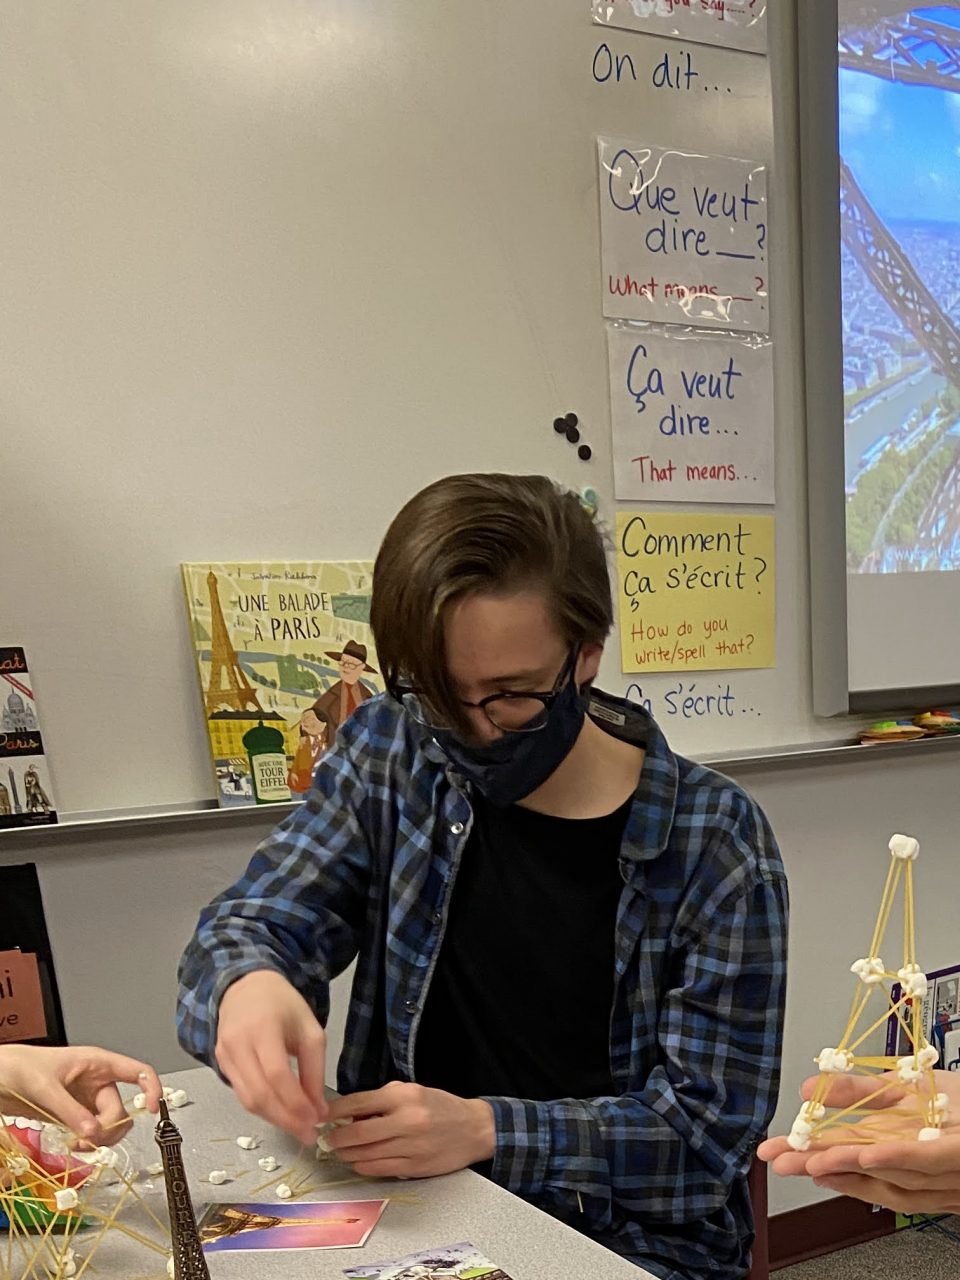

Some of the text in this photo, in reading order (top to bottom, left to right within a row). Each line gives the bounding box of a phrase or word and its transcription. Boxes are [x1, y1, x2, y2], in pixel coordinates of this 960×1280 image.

[592, 44, 636, 82] On
[609, 150, 759, 220] Que veut
[609, 274, 659, 298] What
[627, 344, 742, 413] Ça veut
[632, 456, 677, 483] That
[622, 517, 752, 557] Comment
[238, 592, 329, 612] UNE BALADE
[254, 612, 321, 641] À PARIS
[631, 618, 728, 642] How do you
[635, 634, 755, 665] write/spell that?
[260, 767, 284, 778] TOUR
[260, 777, 288, 788] EIFFEL
